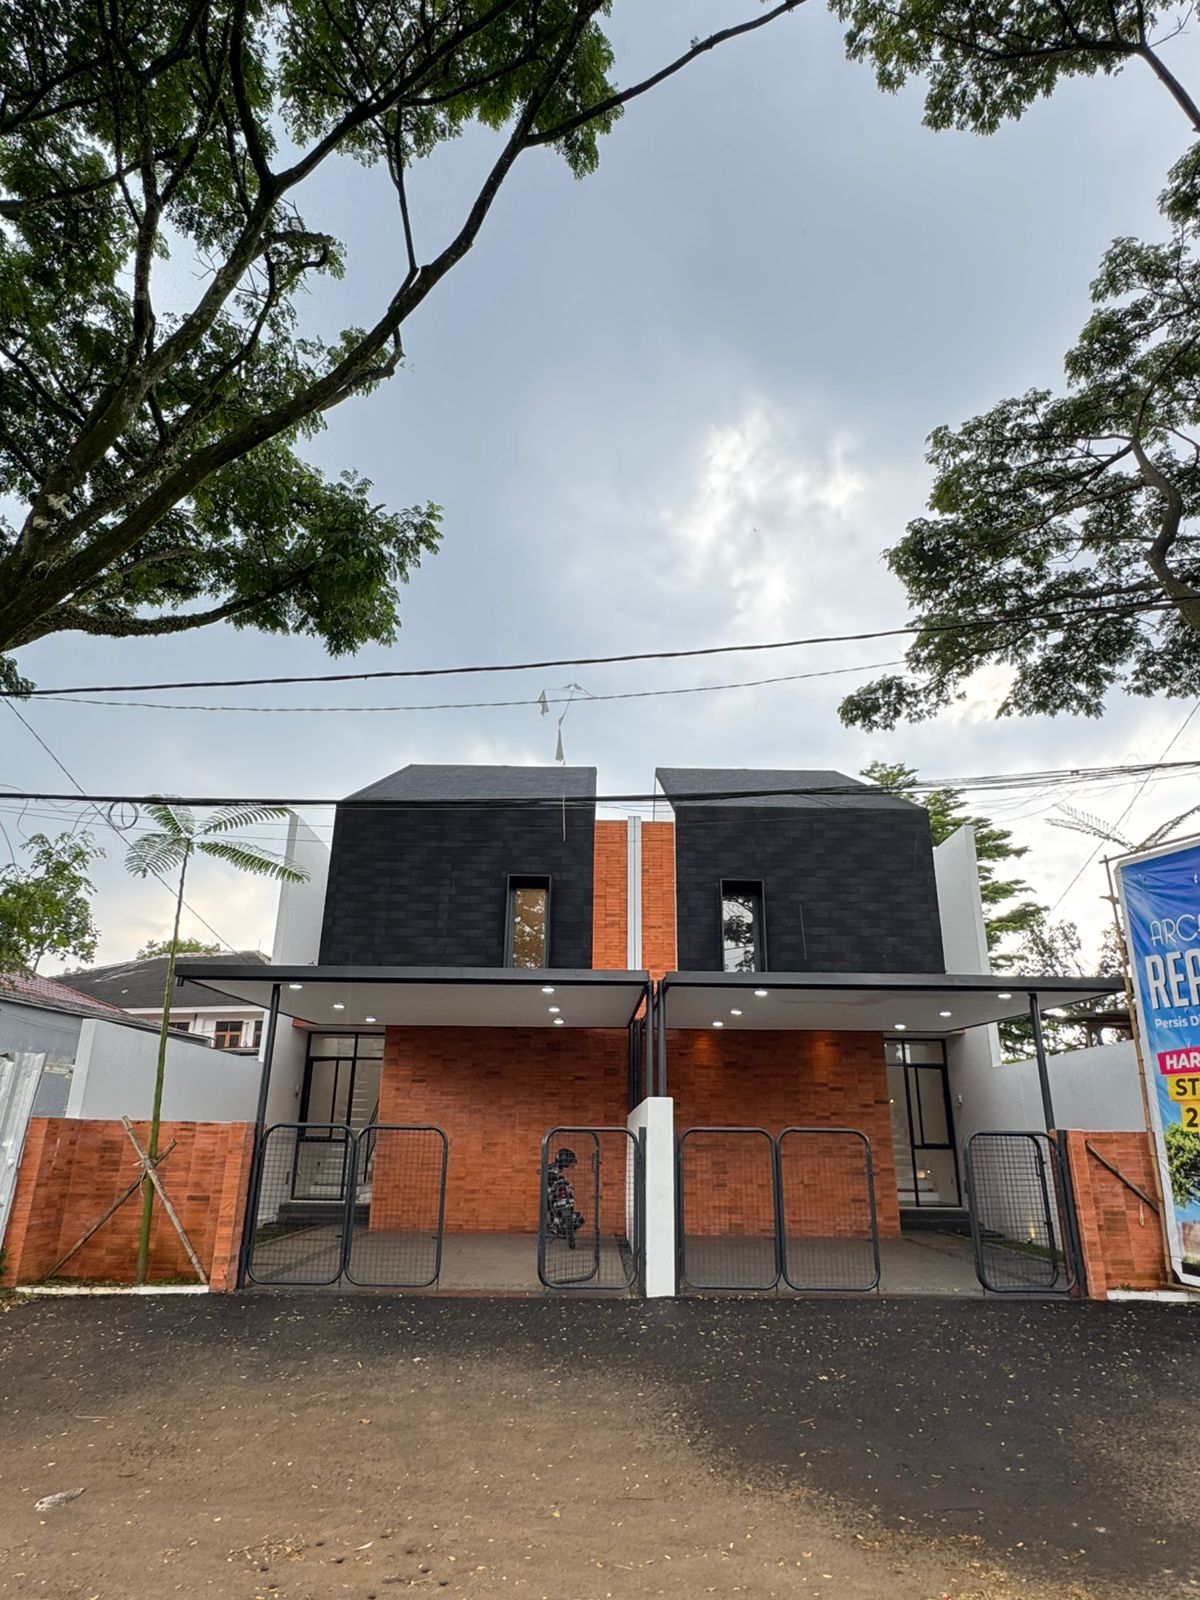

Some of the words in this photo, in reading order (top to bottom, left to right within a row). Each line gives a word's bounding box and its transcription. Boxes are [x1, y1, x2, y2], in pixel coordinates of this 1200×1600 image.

[1150, 914, 1200, 947] ARC
[1155, 1017, 1188, 1029] Persis
[1190, 1015, 1200, 1027] D
[1165, 1052, 1200, 1070] HAR
[1185, 1107, 1199, 1128] 2
